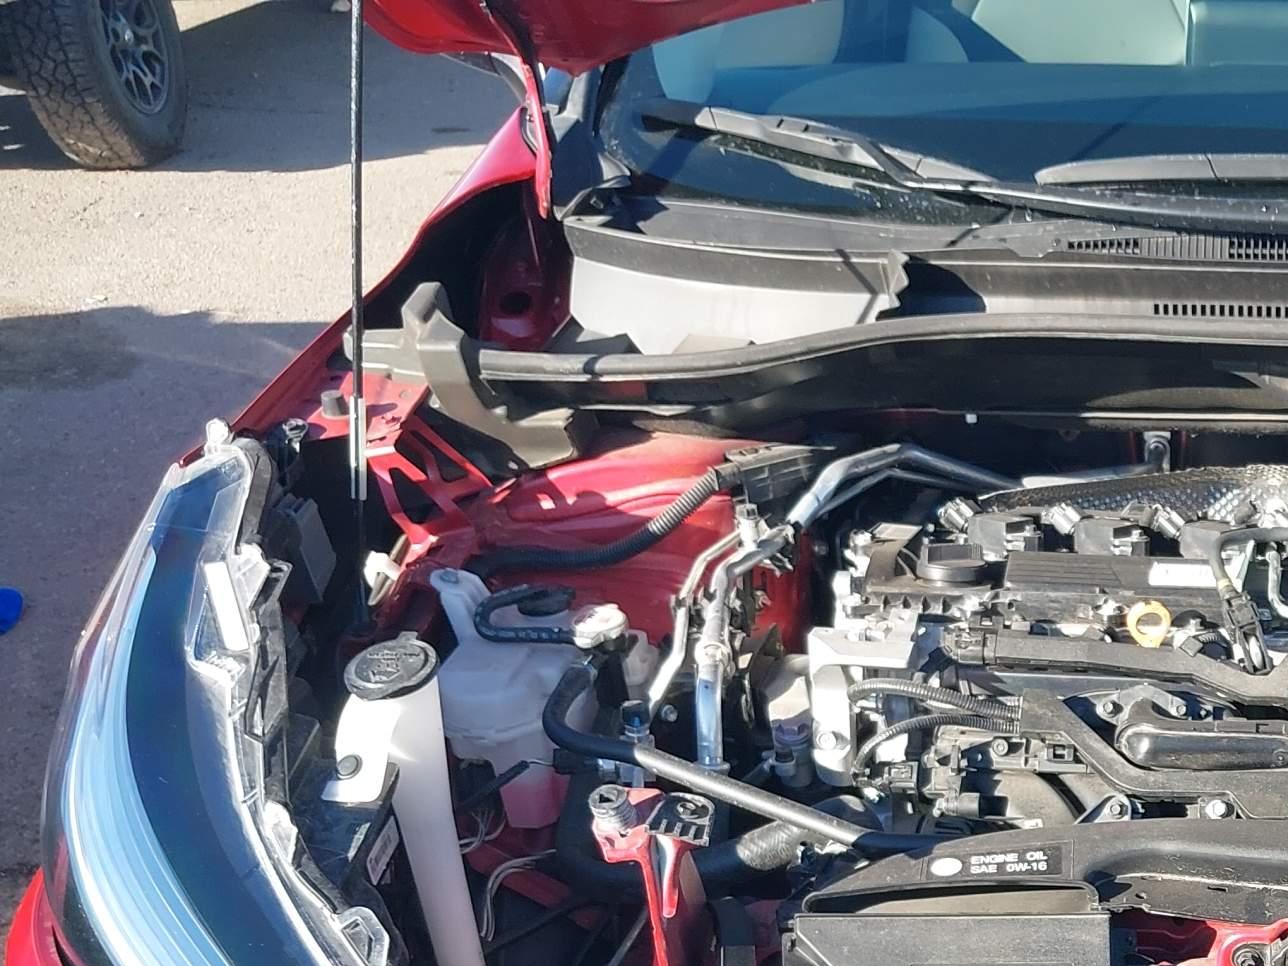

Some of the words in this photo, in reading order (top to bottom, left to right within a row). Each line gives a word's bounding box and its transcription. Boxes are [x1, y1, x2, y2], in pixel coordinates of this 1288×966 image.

[970, 852, 1019, 865] ENGINE
[1026, 850, 1048, 861] OIL
[970, 864, 998, 874] SAE
[1006, 861, 1048, 873] 0W-16
